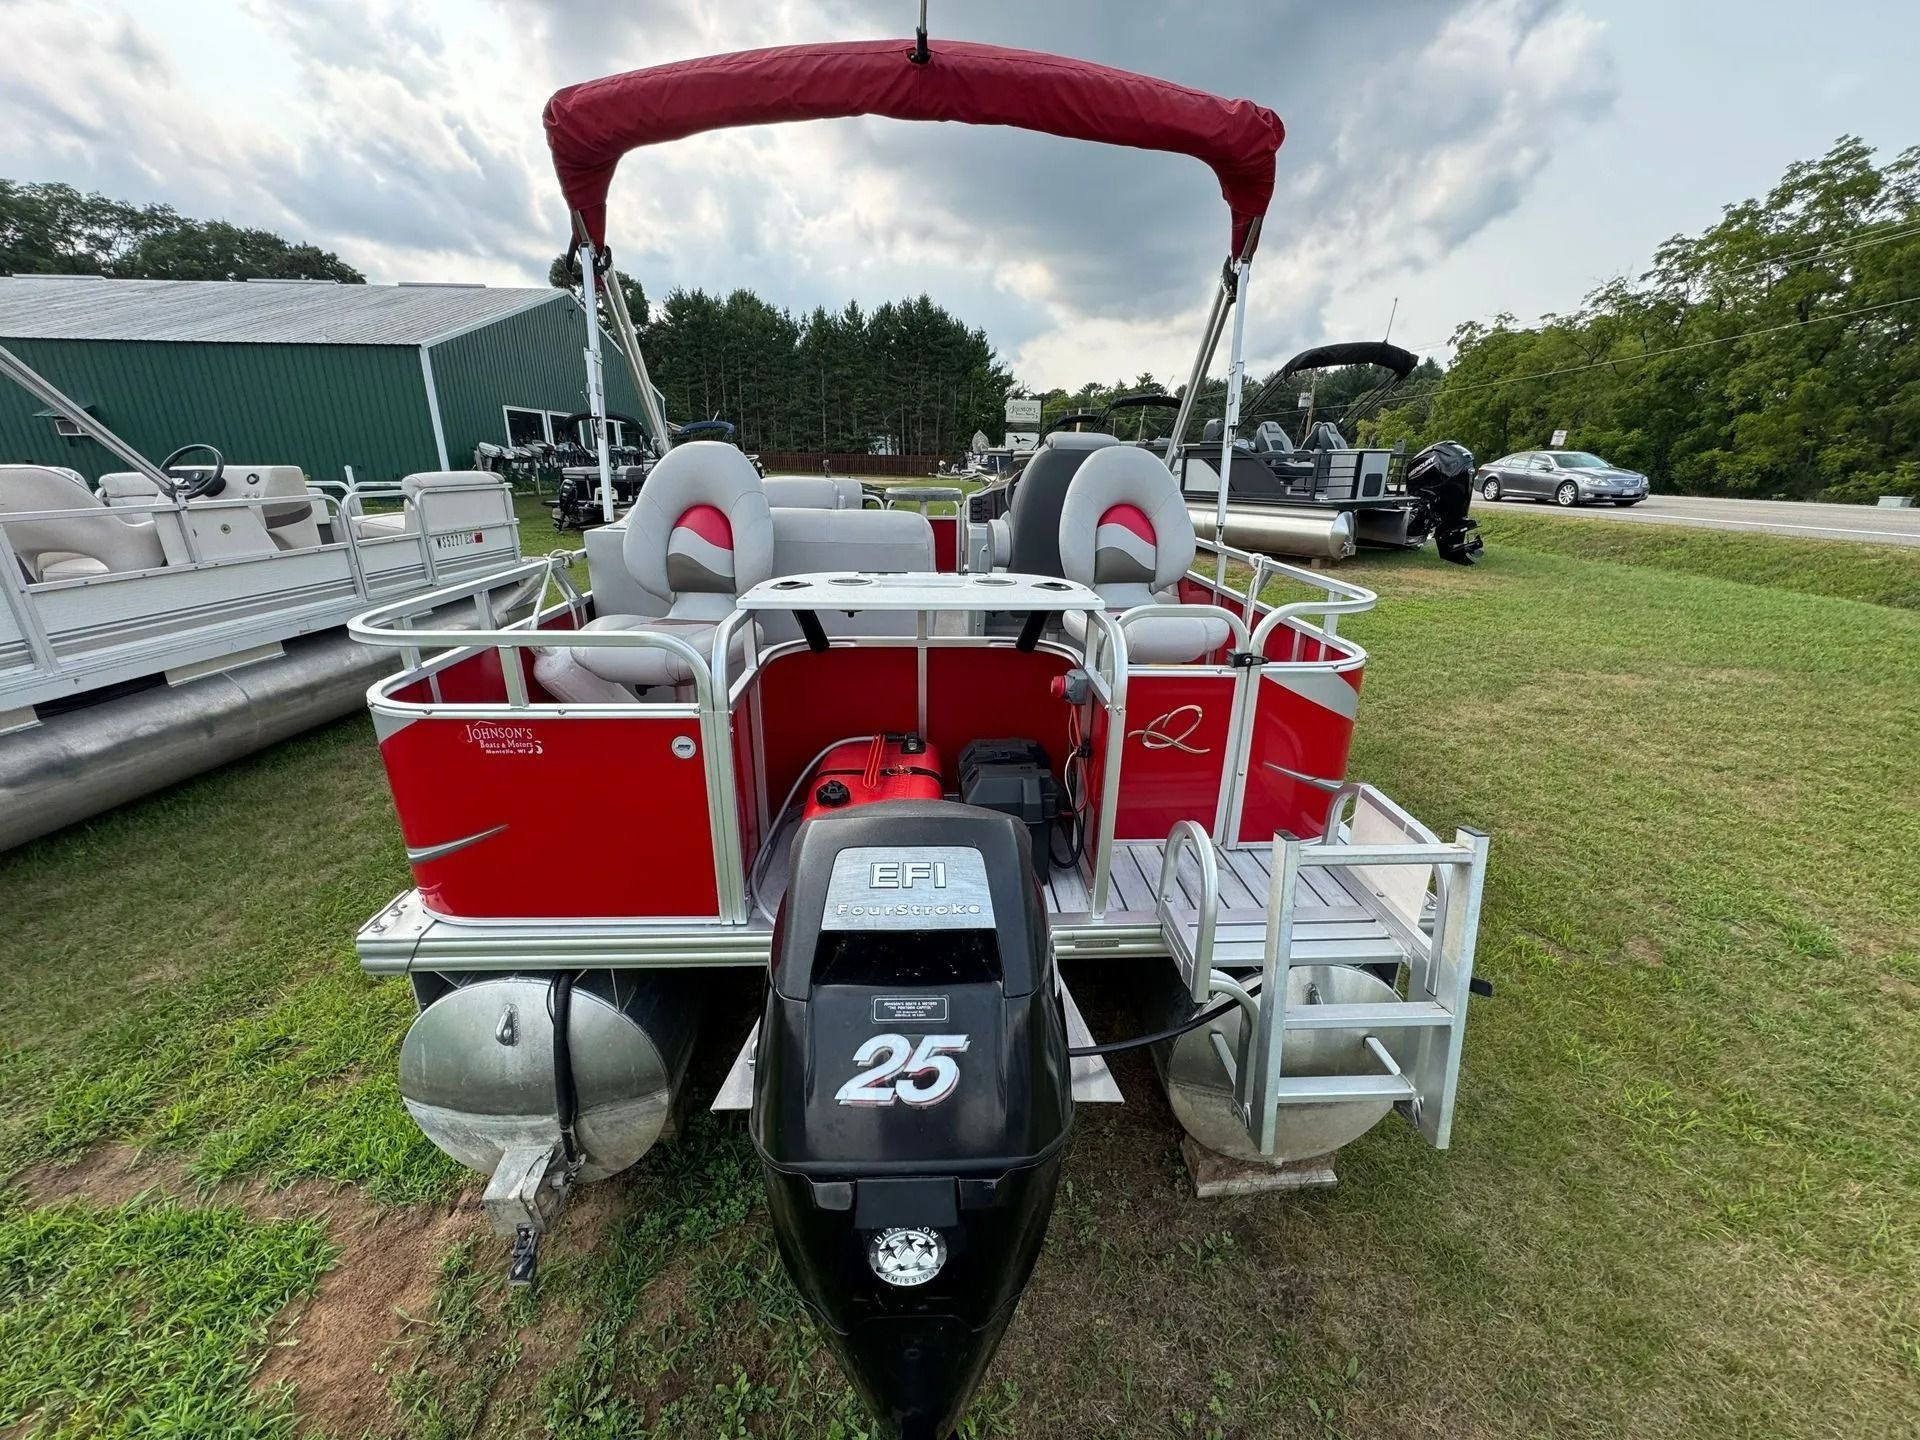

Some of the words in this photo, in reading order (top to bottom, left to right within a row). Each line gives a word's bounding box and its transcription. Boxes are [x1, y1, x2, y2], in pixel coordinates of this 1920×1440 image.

[465, 725, 533, 743] JOHNSON'S
[480, 740, 500, 748] Boats
[507, 739, 533, 748] Motors
[869, 862, 947, 888] EFI
[836, 903, 981, 917] FourStroke
[833, 1033, 970, 1109] 25
[884, 1270, 936, 1284] EMISSION
